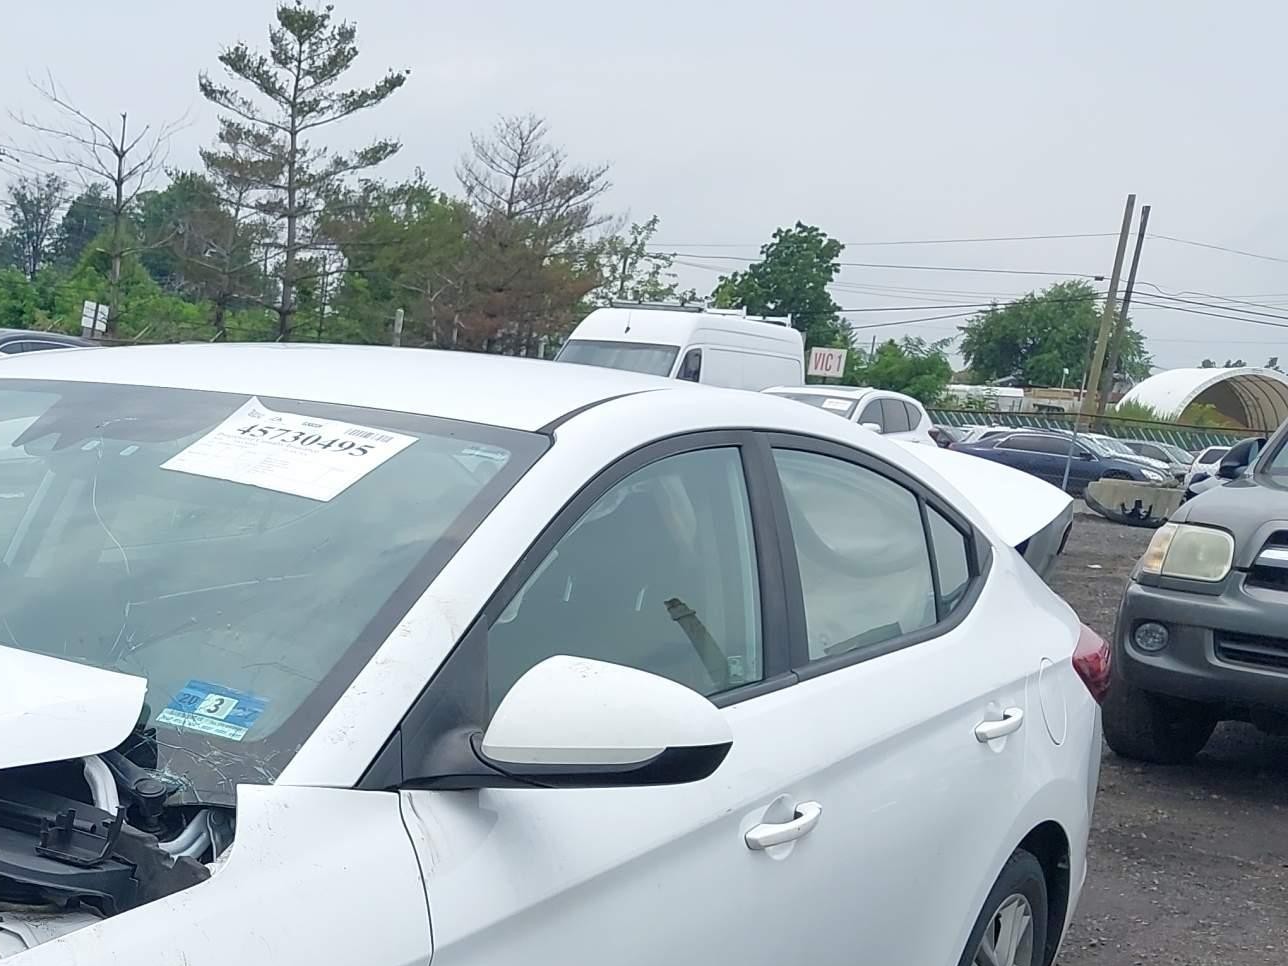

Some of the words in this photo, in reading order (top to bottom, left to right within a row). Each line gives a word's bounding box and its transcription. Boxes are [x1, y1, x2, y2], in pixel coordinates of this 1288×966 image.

[814, 352, 833, 372] VIC
[837, 354, 843, 372] 1
[237, 424, 375, 457] 45730495
[179, 693, 200, 706] 20
[206, 697, 225, 714] 3
